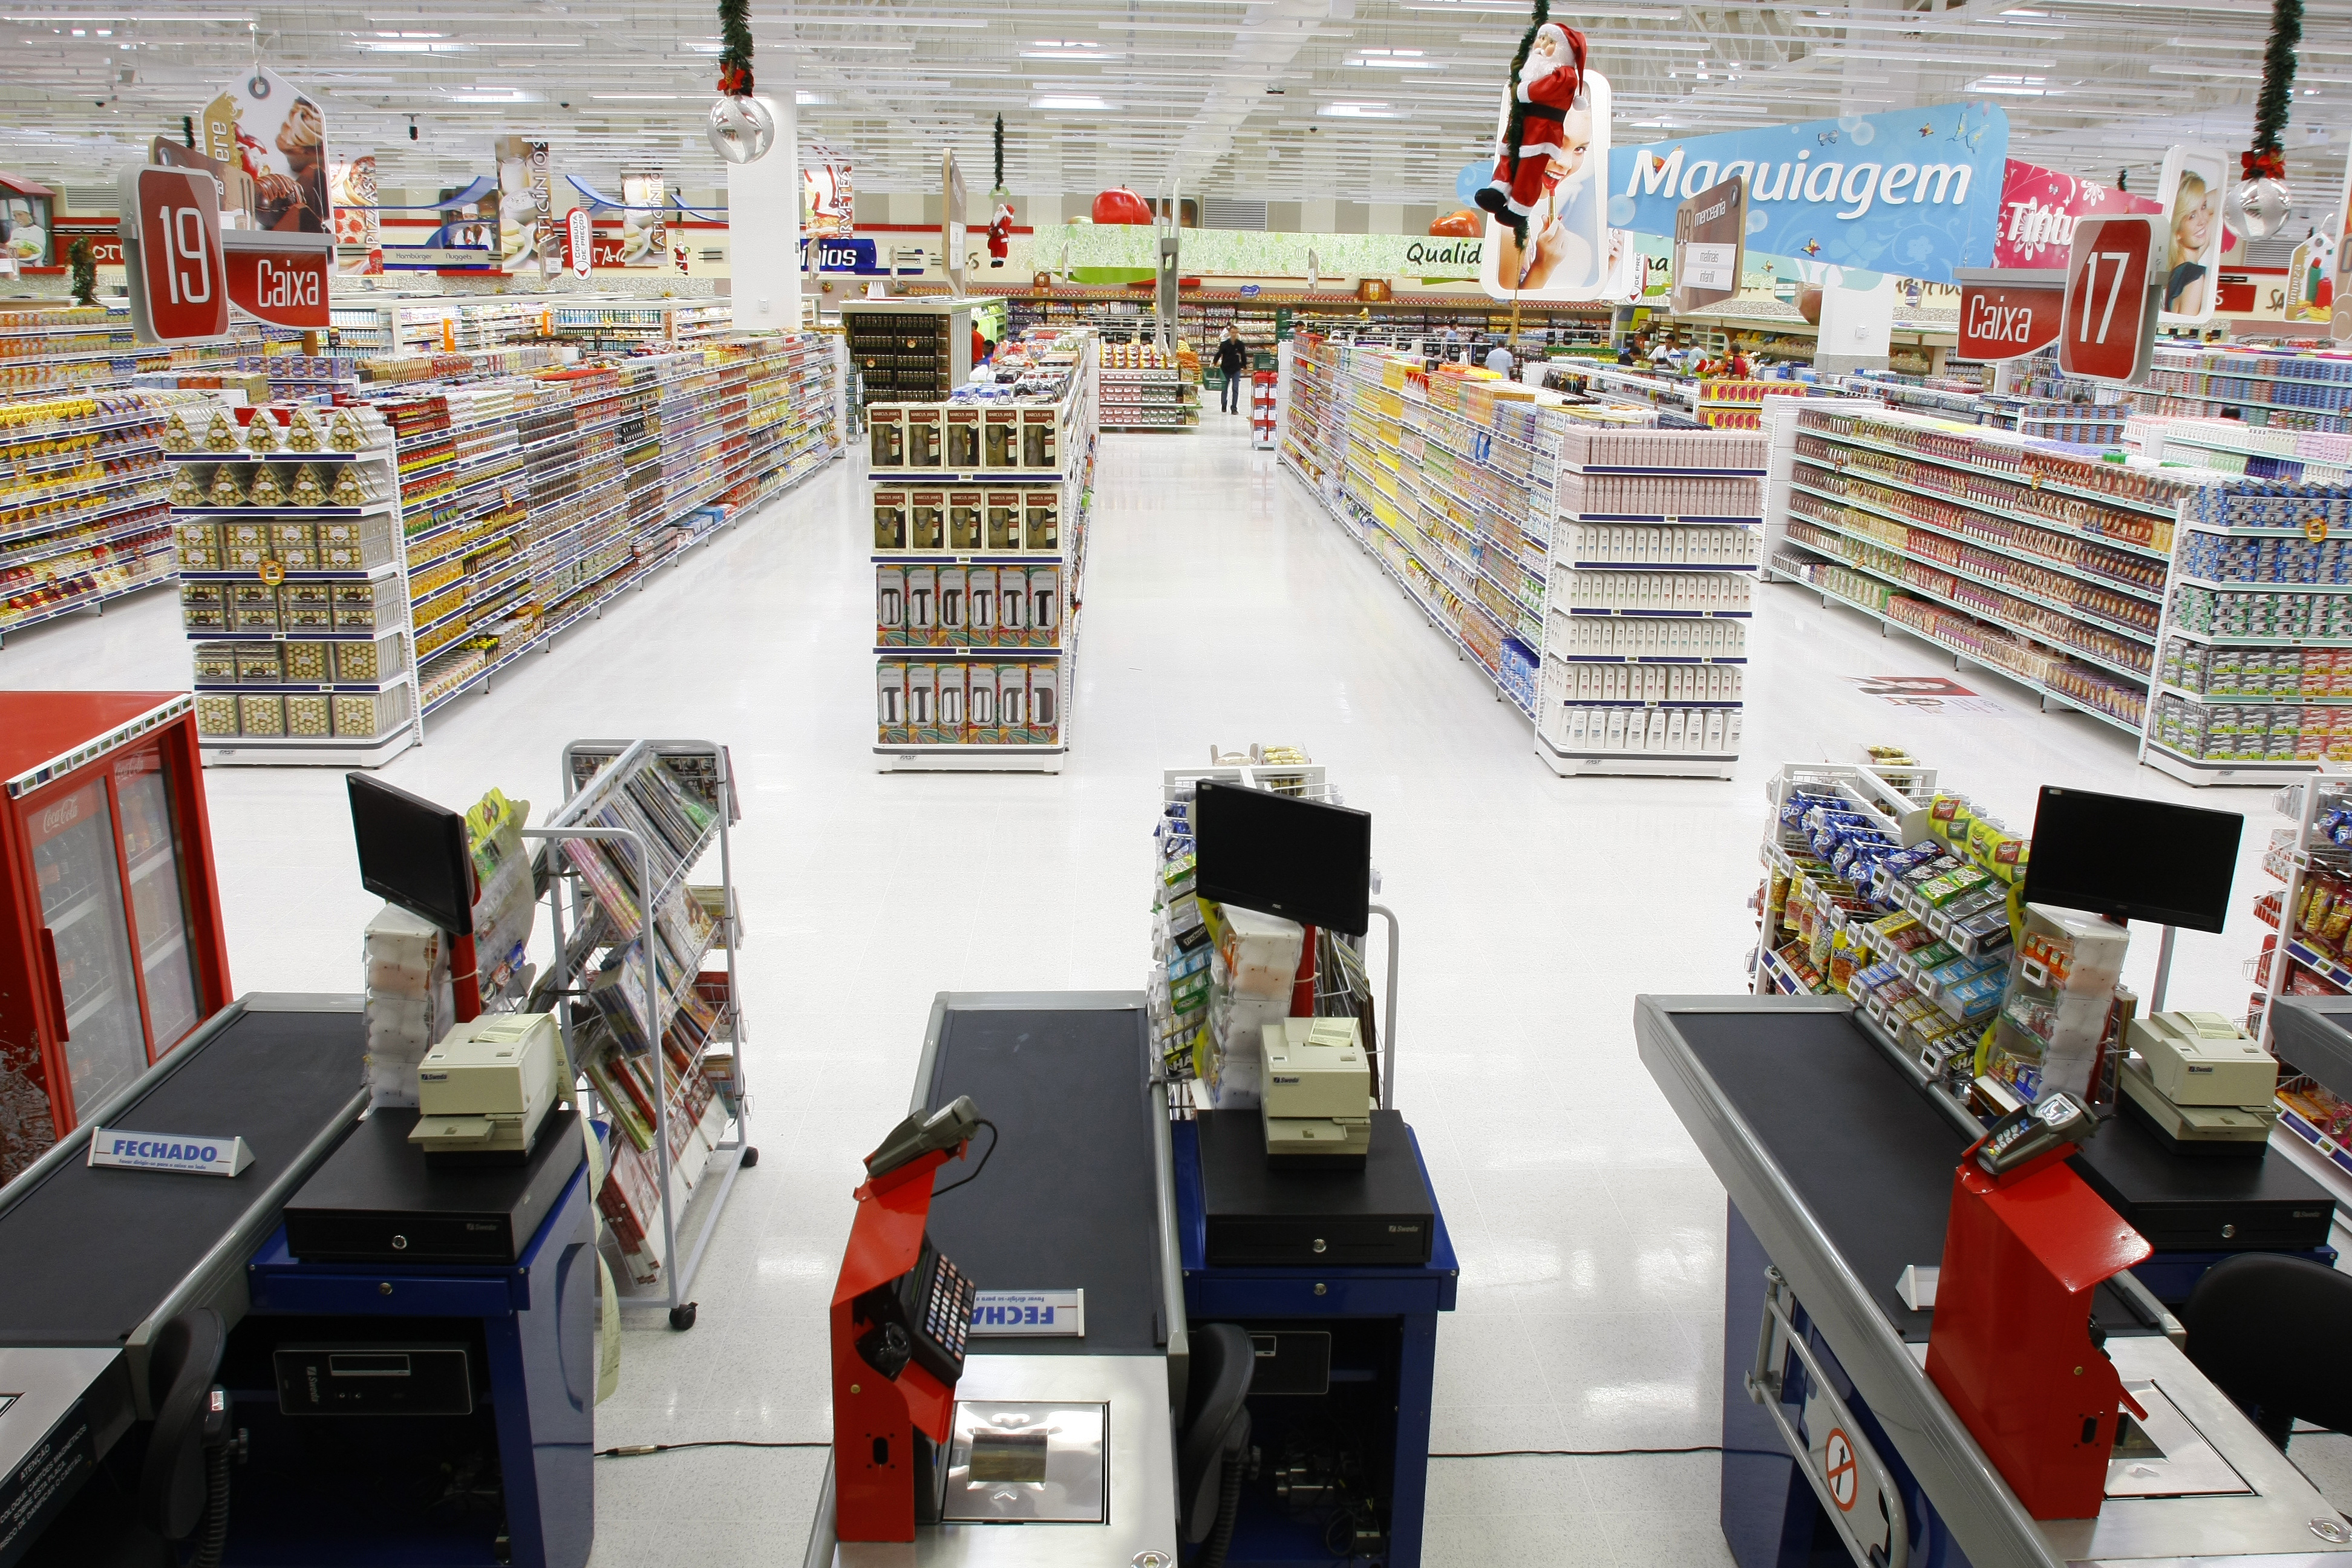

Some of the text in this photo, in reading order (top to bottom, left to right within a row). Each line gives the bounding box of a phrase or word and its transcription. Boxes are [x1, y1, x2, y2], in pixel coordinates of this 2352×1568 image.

[1694, 197, 1726, 227] mercearia
[158, 207, 211, 304] 19
[256, 259, 319, 307] Caixa
[2080, 251, 2130, 344] 17
[2287, 264, 2302, 306] limpeza
[1967, 294, 2032, 343] Caixa
[1183, 926, 1206, 945] Trident
[113, 1139, 218, 1163] FECHADO
